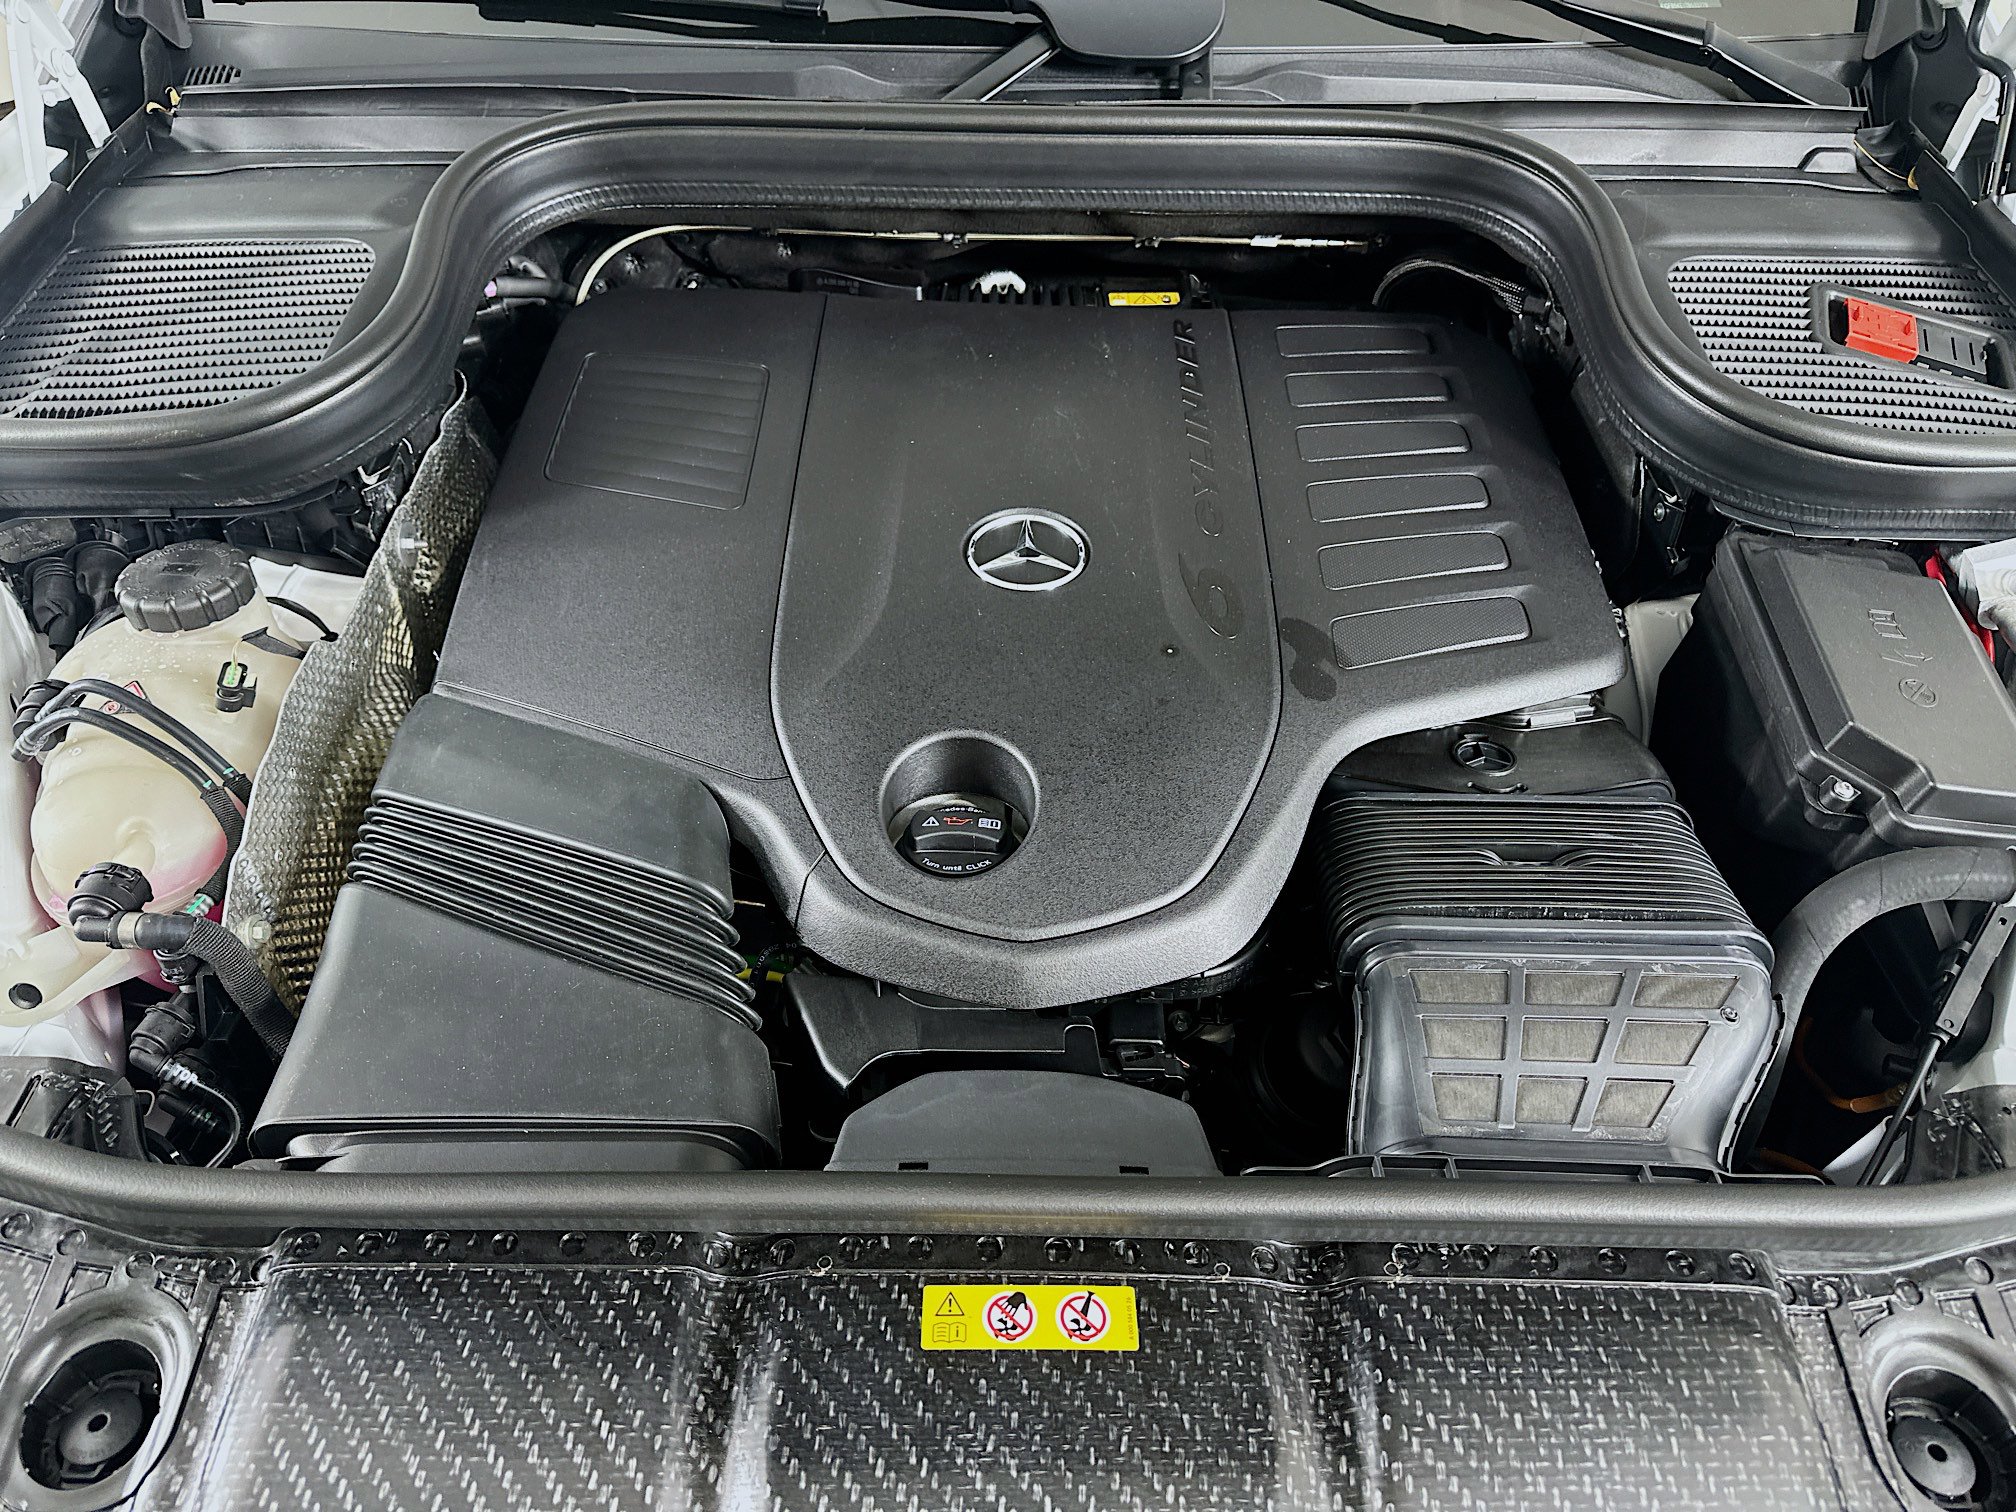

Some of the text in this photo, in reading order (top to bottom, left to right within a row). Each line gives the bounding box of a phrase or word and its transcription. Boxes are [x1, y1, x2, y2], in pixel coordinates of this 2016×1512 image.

[1173, 318, 1244, 640] 6 CYLINDER
[922, 857, 992, 872] Turn until CLICK
